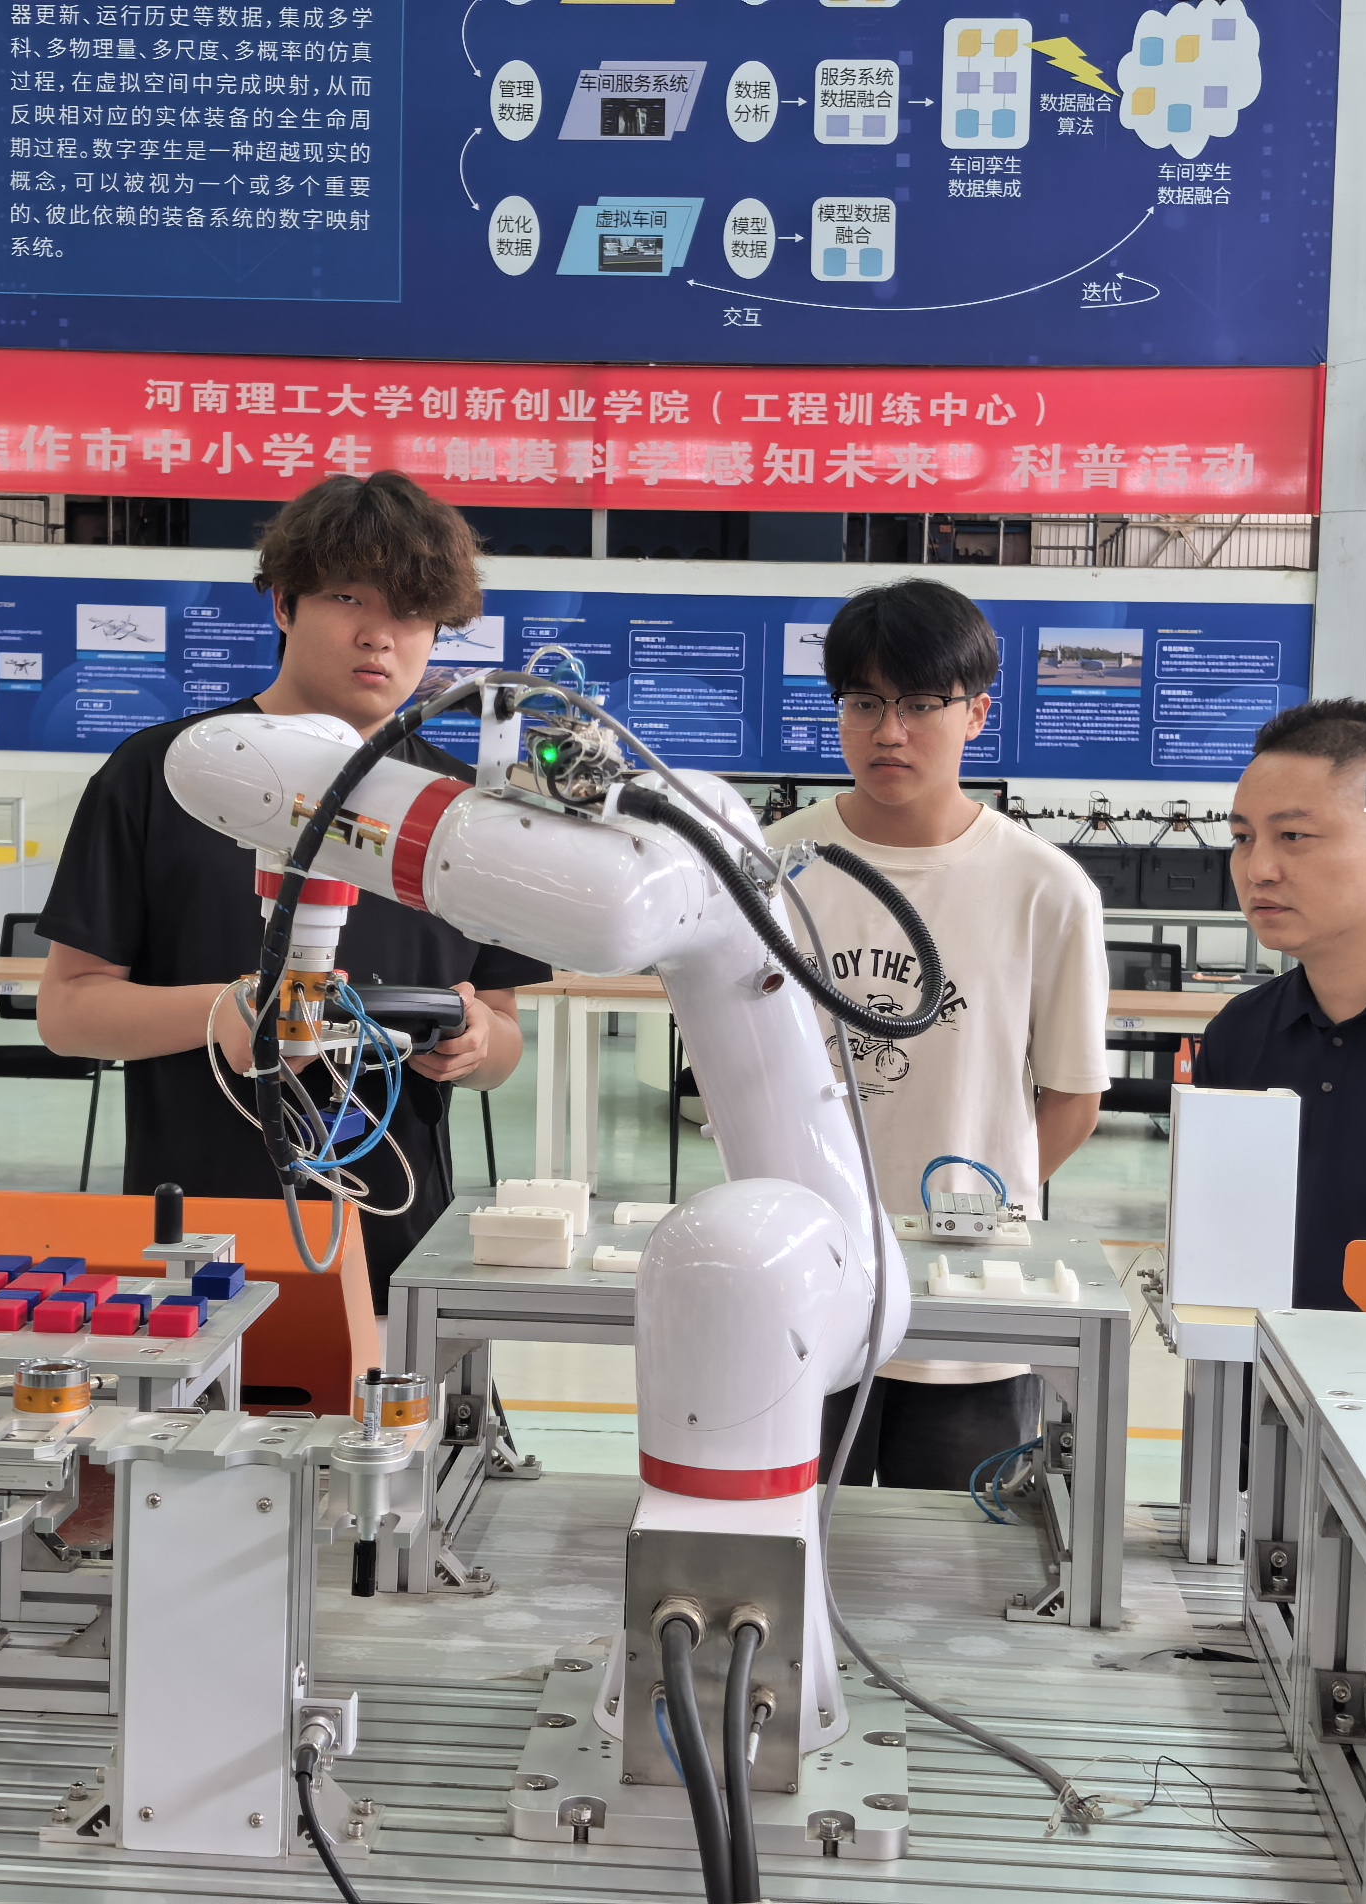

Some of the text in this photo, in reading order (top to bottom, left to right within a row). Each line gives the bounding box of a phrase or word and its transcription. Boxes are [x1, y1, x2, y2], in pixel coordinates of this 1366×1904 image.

[11, 38, 372, 62] 科、多物理量、多尺度、多概率的仿真
[578, 72, 688, 92] 车间服务系统
[821, 68, 893, 85] 服务系统
[499, 80, 534, 97] 管理
[735, 81, 770, 99] 数据
[820, 90, 892, 108] 数据融合
[1040, 92, 1115, 112] 数据融合
[11, 104, 369, 130] 反映相对应的实体装备的全生命周
[498, 103, 533, 121] 数据
[735, 105, 770, 122] 分析
[1057, 117, 1093, 135] 算法
[10, 137, 370, 163] 期过程。数字孪生是一种超越现实的
[949, 156, 1021, 174] 车间孪生
[1158, 163, 1231, 181] 车间孪生
[948, 179, 1021, 197] 数据集成
[1157, 186, 1231, 204] 数据融合
[11, 203, 370, 230] 的、彼此依赖的装备系统的数字映射
[596, 210, 667, 228] 虚拟车间
[818, 204, 890, 222] 模型数据
[497, 216, 532, 233] 优化
[732, 217, 767, 234] 模型
[836, 226, 871, 244] 融合
[12, 237, 63, 257] 系统。
[497, 239, 532, 256] 数据
[732, 240, 767, 258] 数据
[1082, 282, 1124, 304] 迭代
[723, 307, 762, 326] 交互
[144, 378, 1046, 428] 河南理工大学创新创业学院（工程训练中心）
[871, 949, 916, 983] THE
